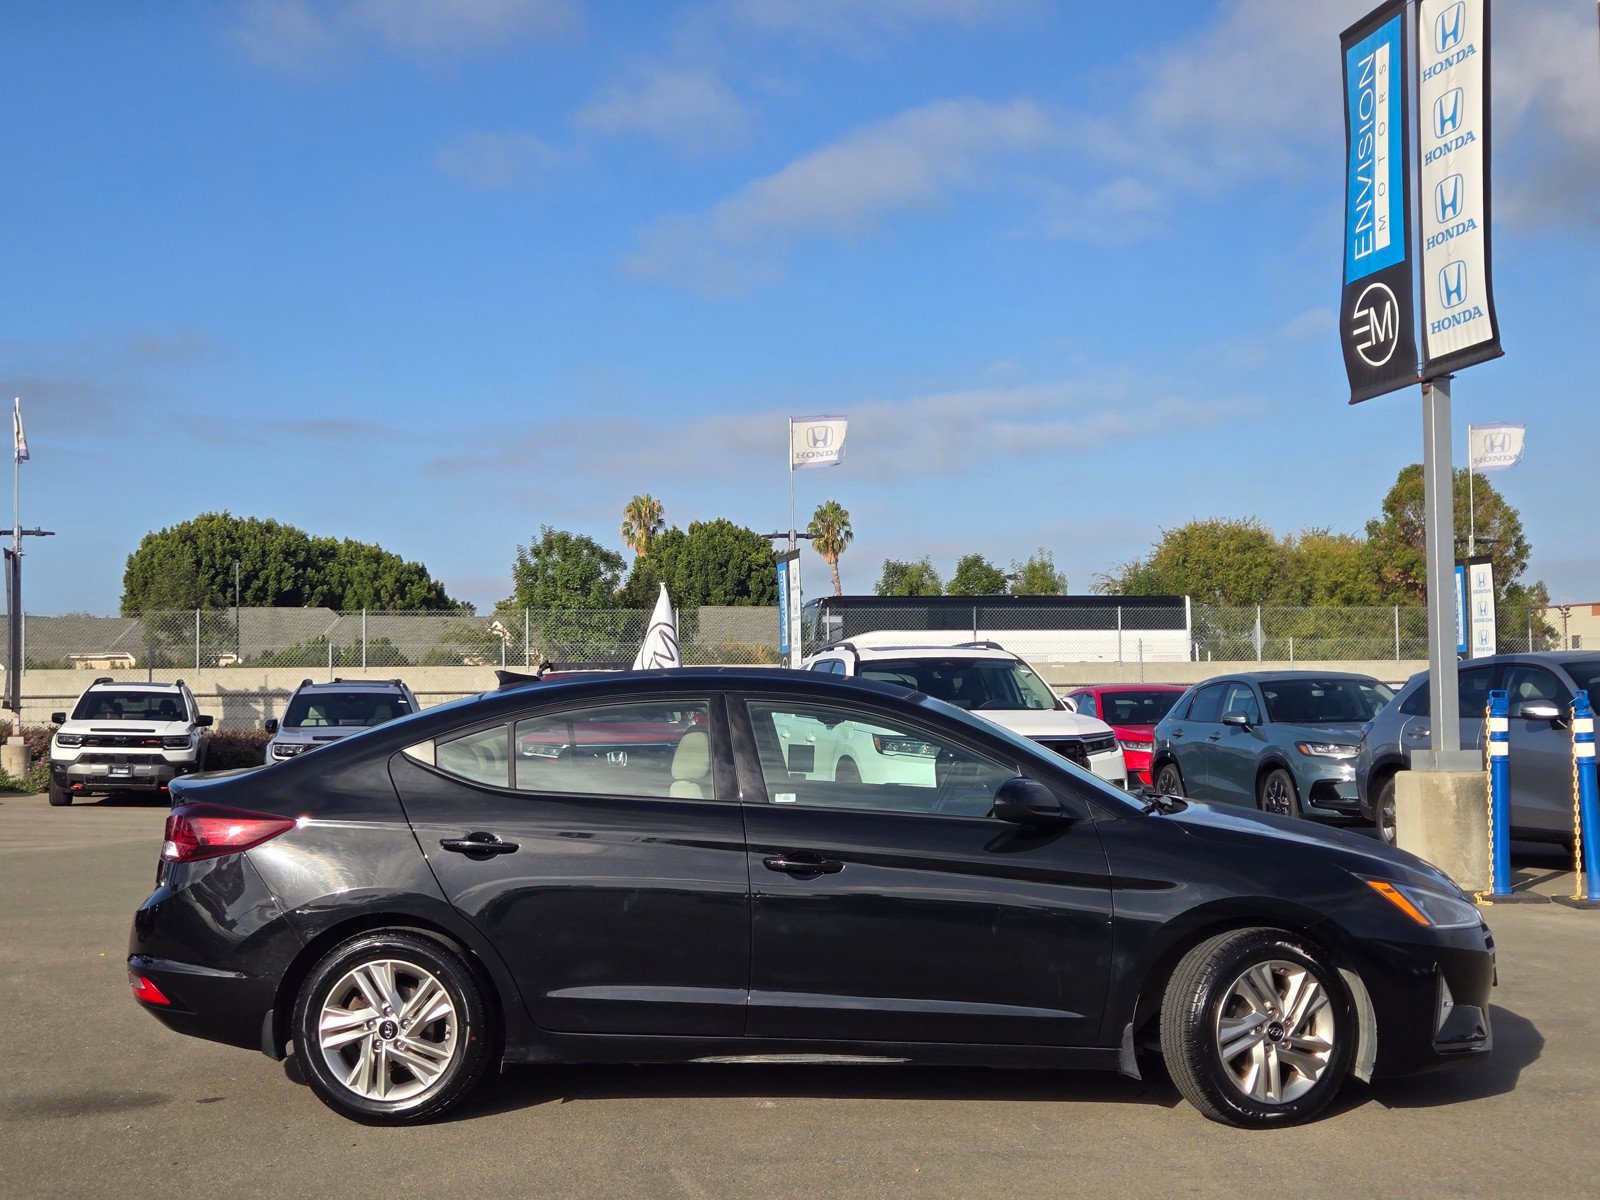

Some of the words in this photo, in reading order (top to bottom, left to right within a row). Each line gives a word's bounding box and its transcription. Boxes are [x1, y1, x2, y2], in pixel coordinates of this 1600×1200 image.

[1422, 43, 1477, 83] HONDA
[1354, 52, 1375, 260] ENVISION
[1378, 63, 1387, 232] MOTORS
[1424, 130, 1477, 167] HONDA
[1426, 218, 1478, 251] HONDA
[1430, 305, 1484, 335] HONDA
